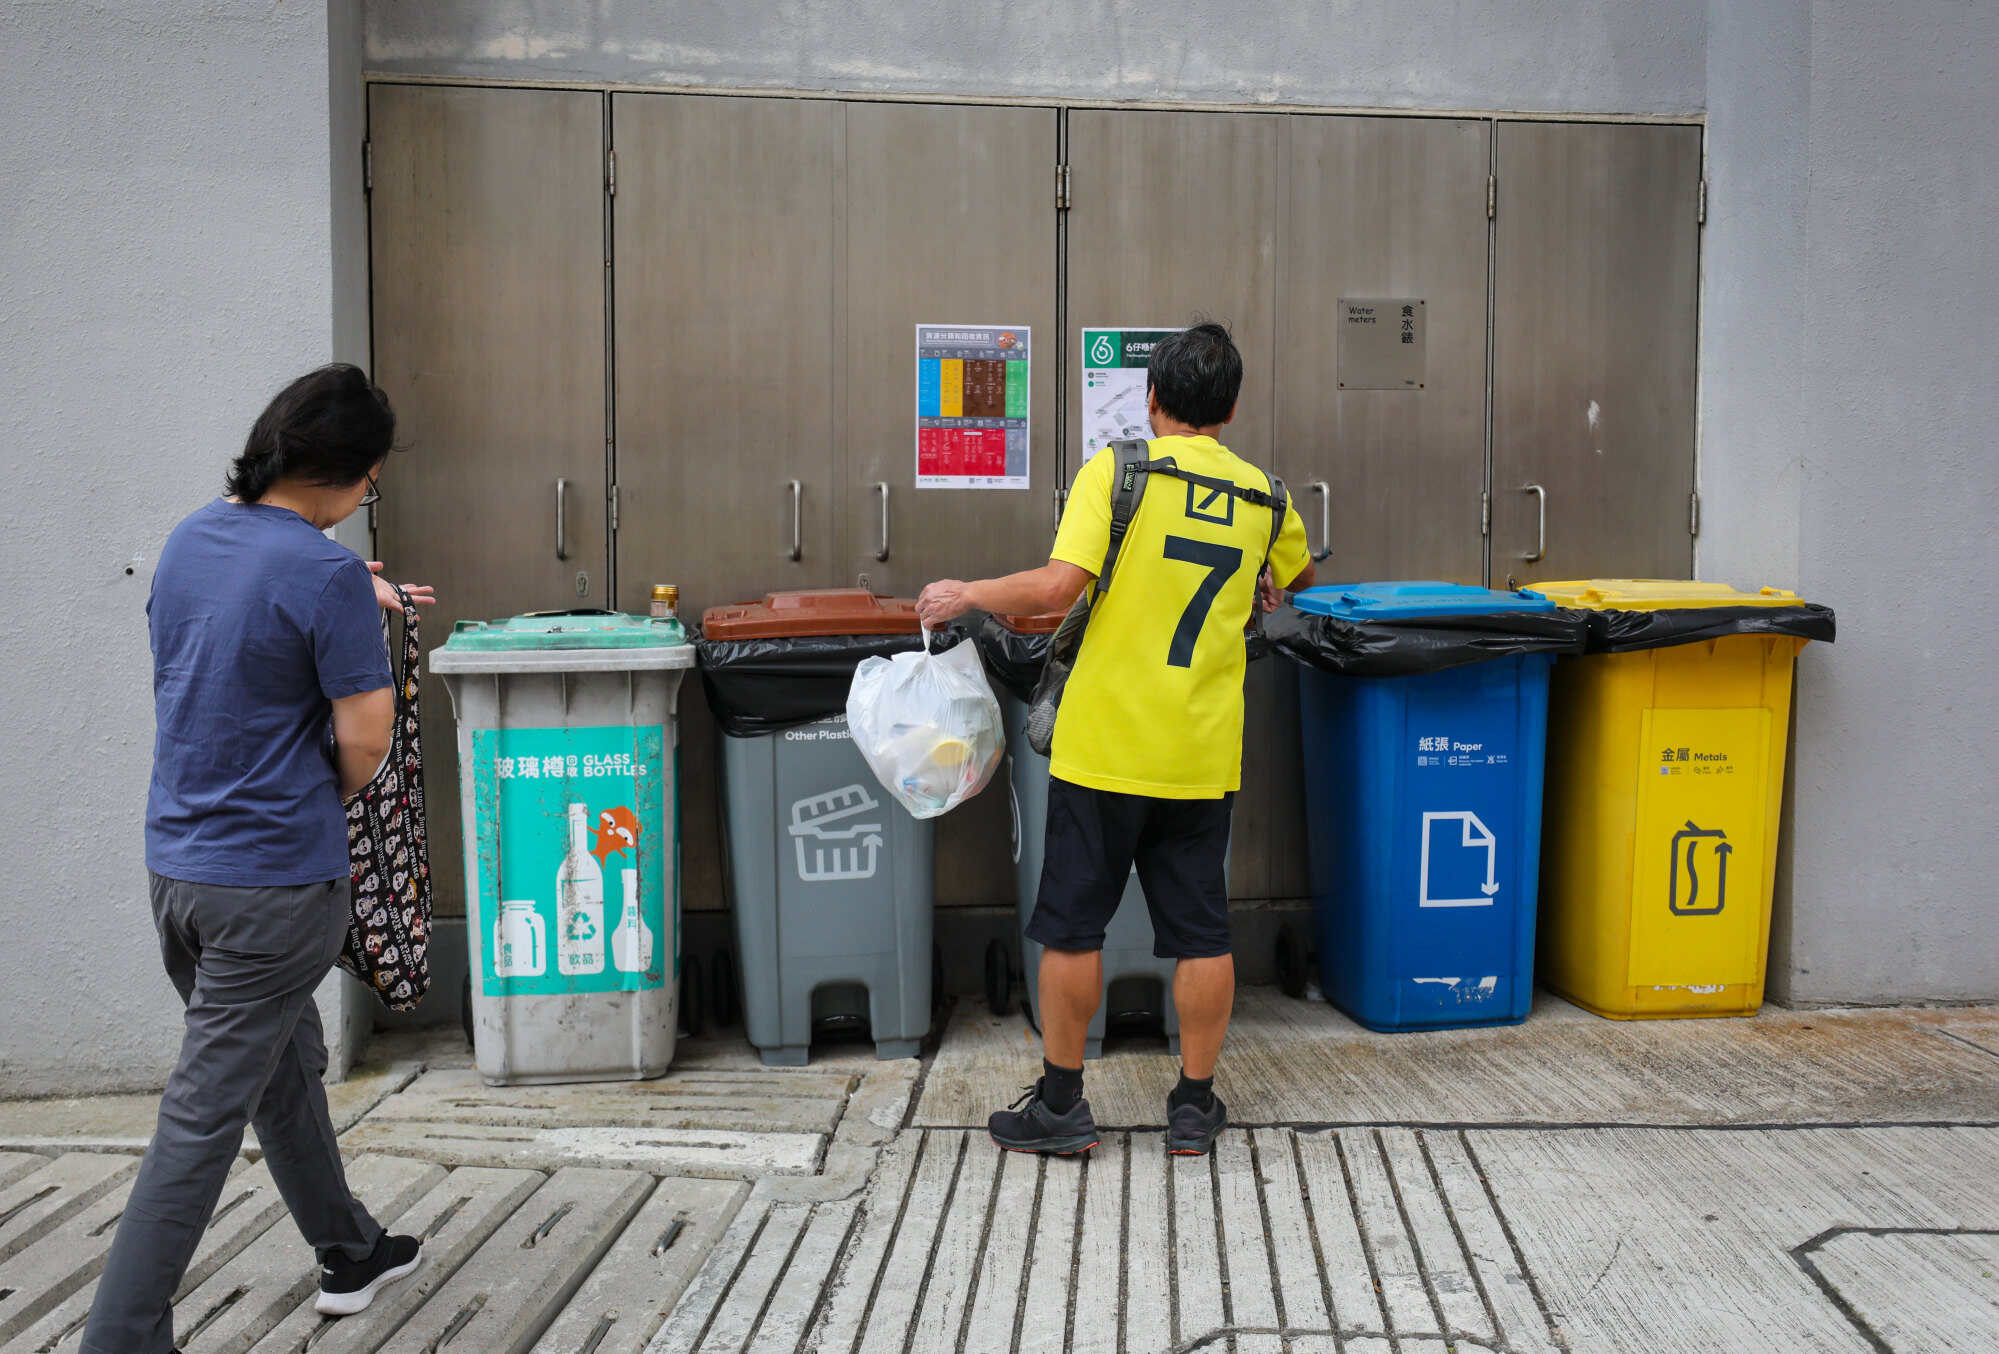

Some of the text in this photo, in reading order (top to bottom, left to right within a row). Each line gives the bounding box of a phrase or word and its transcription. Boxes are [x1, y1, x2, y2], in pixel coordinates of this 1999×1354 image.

[1163, 534, 1243, 668] 7
[785, 731, 817, 740] Other
[1419, 736, 1482, 753] 紙張 Paper
[583, 753, 630, 766] GLASS
[1661, 747, 1728, 761] 金屬 Metals
[583, 765, 647, 777] BOTTLES
